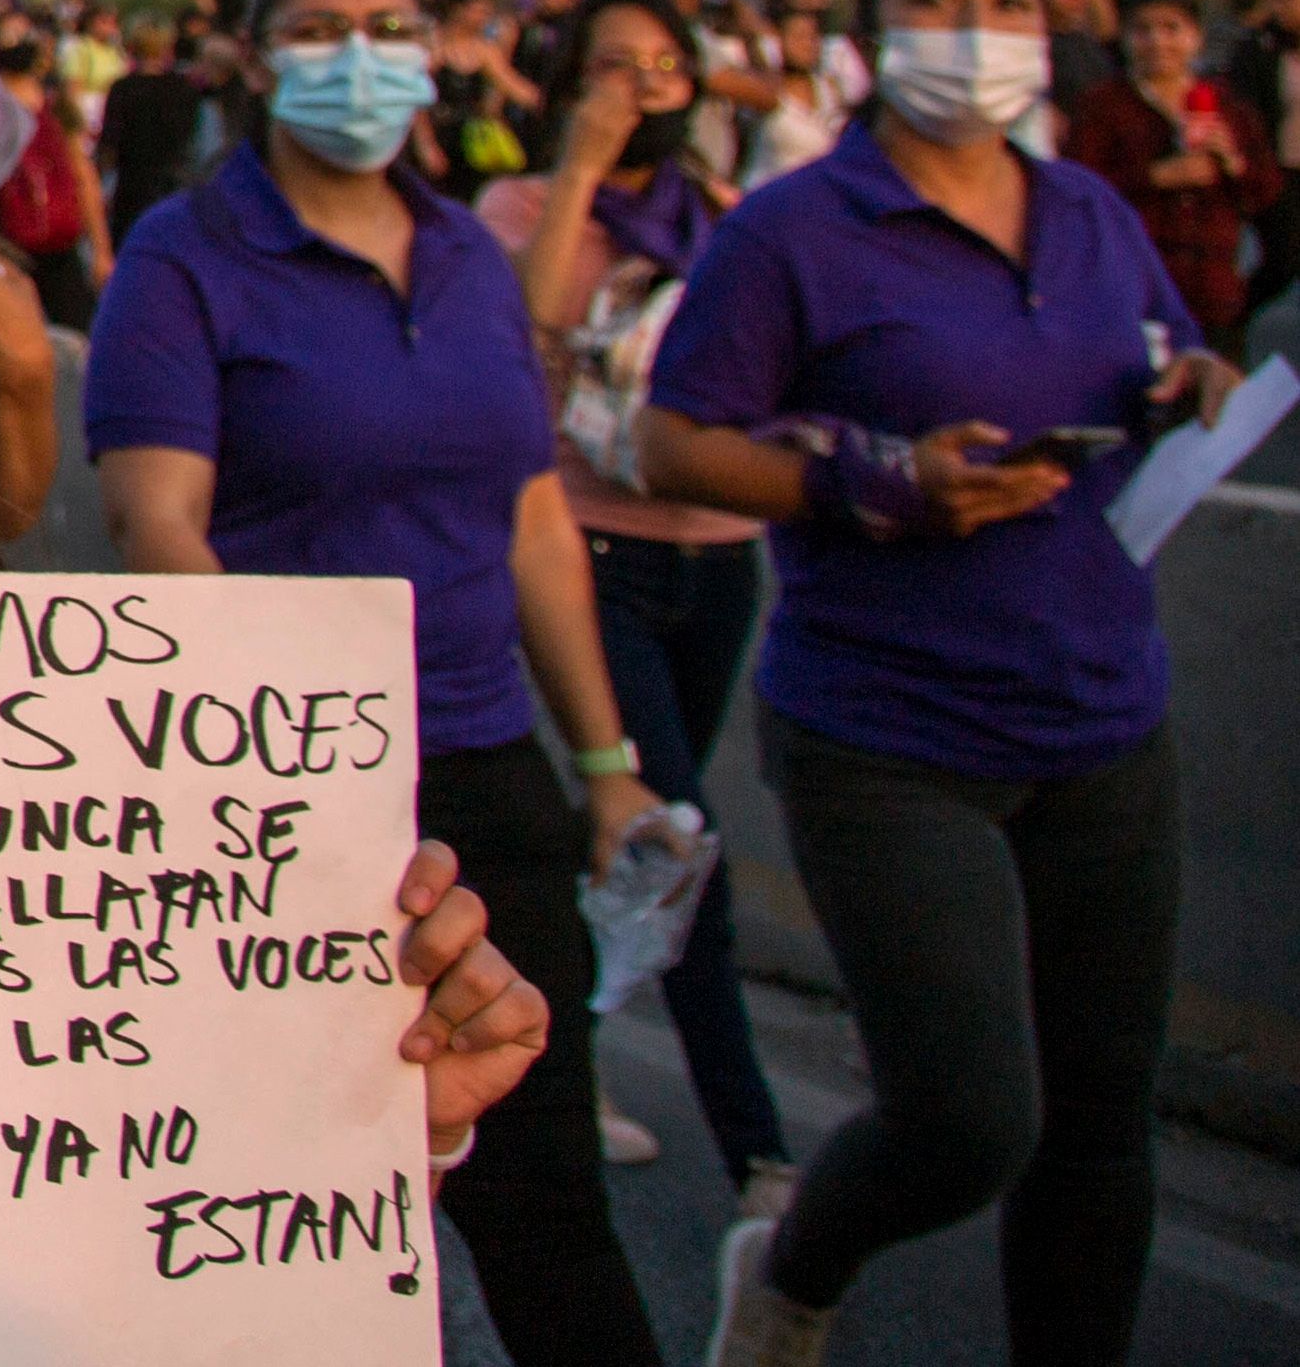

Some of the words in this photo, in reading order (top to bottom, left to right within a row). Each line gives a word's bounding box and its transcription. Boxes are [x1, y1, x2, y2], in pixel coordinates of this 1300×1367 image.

[107, 685, 391, 778] VOCES
[211, 795, 312, 864] SE
[68, 938, 180, 989] LAS
[217, 929, 394, 992] VOCES
[13, 1011, 150, 1067] LAS
[0, 1113, 100, 1200] YA
[118, 1105, 199, 1180] NO
[145, 1170, 420, 1296] ESTAN!
